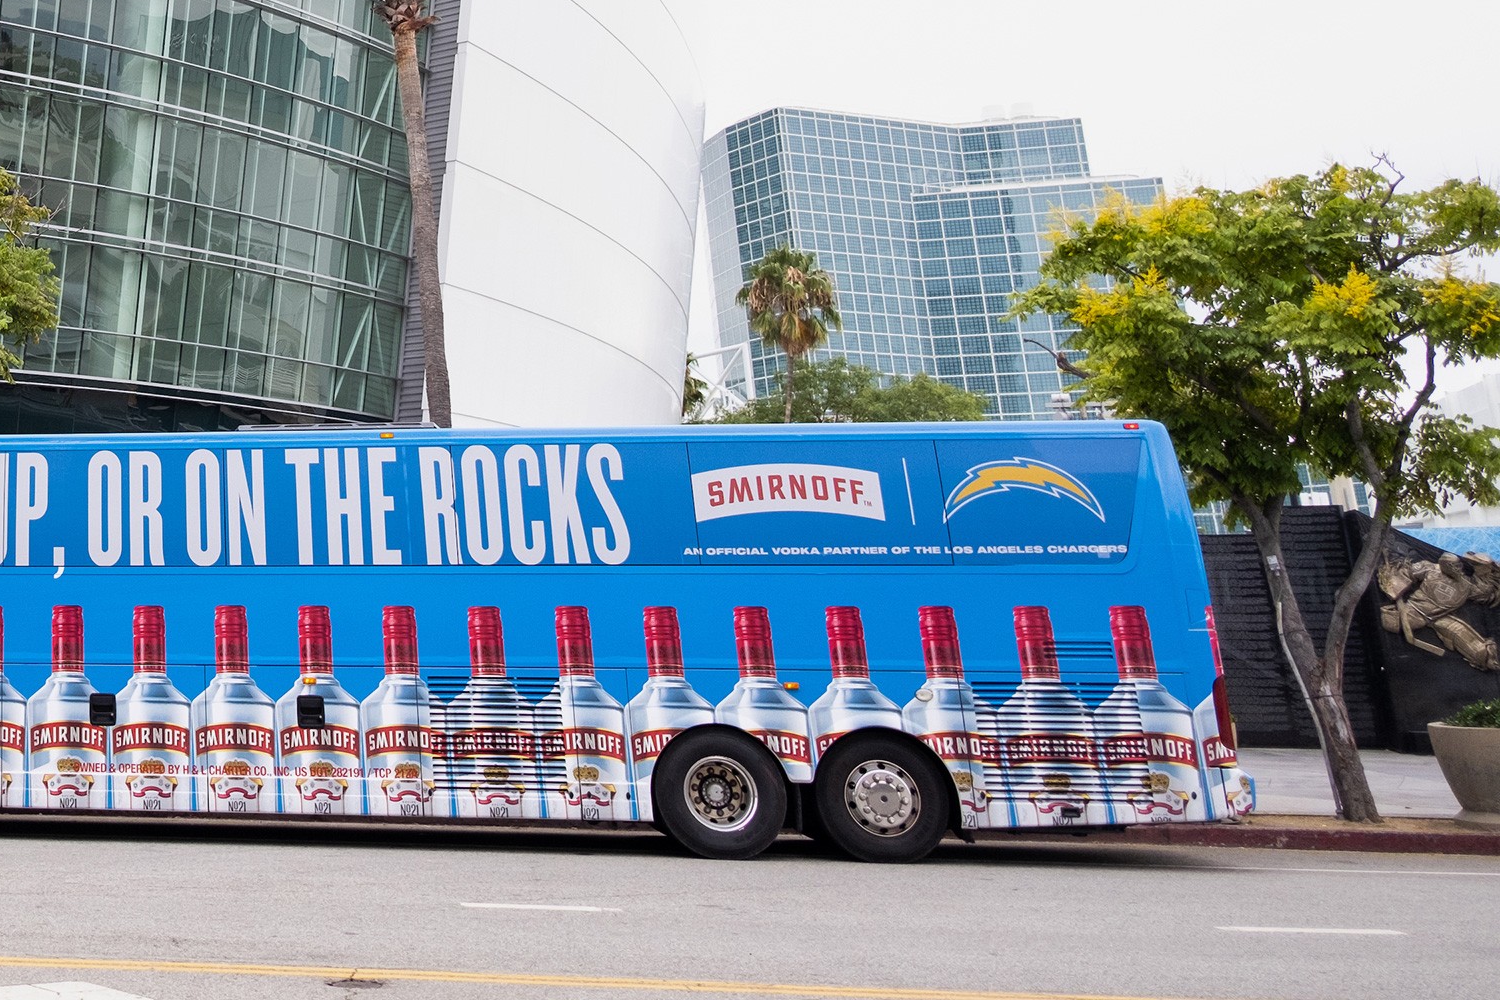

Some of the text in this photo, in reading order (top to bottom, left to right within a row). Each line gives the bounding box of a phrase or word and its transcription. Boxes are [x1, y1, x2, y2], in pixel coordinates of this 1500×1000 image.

[707, 474, 864, 507] SMIRNOFF
[87, 450, 166, 566] OR
[185, 449, 267, 566] ON
[285, 447, 402, 566] THE
[419, 443, 631, 566] ROCKS
[683, 544, 1128, 556] AN OFFICIAL VODKA PARTNER OF THE LOS ANGELES CHARGERS
[33, 726, 104, 748] SMIRNOFF
[115, 727, 187, 750] SMIRNOFF
[198, 727, 273, 751] SMIRNOFF
[283, 728, 357, 752] SMIRNOFF
[74, 763, 107, 773] OWNED
[109, 763, 117, 773] &
[118, 763, 165, 774] OPERATED
[168, 764, 181, 775] BY
[183, 764, 190, 775] H
[191, 765, 199, 775] &
[209, 765, 252, 776] CHARTER
[294, 767, 308, 777] US
[374, 768, 392, 778] TCP
